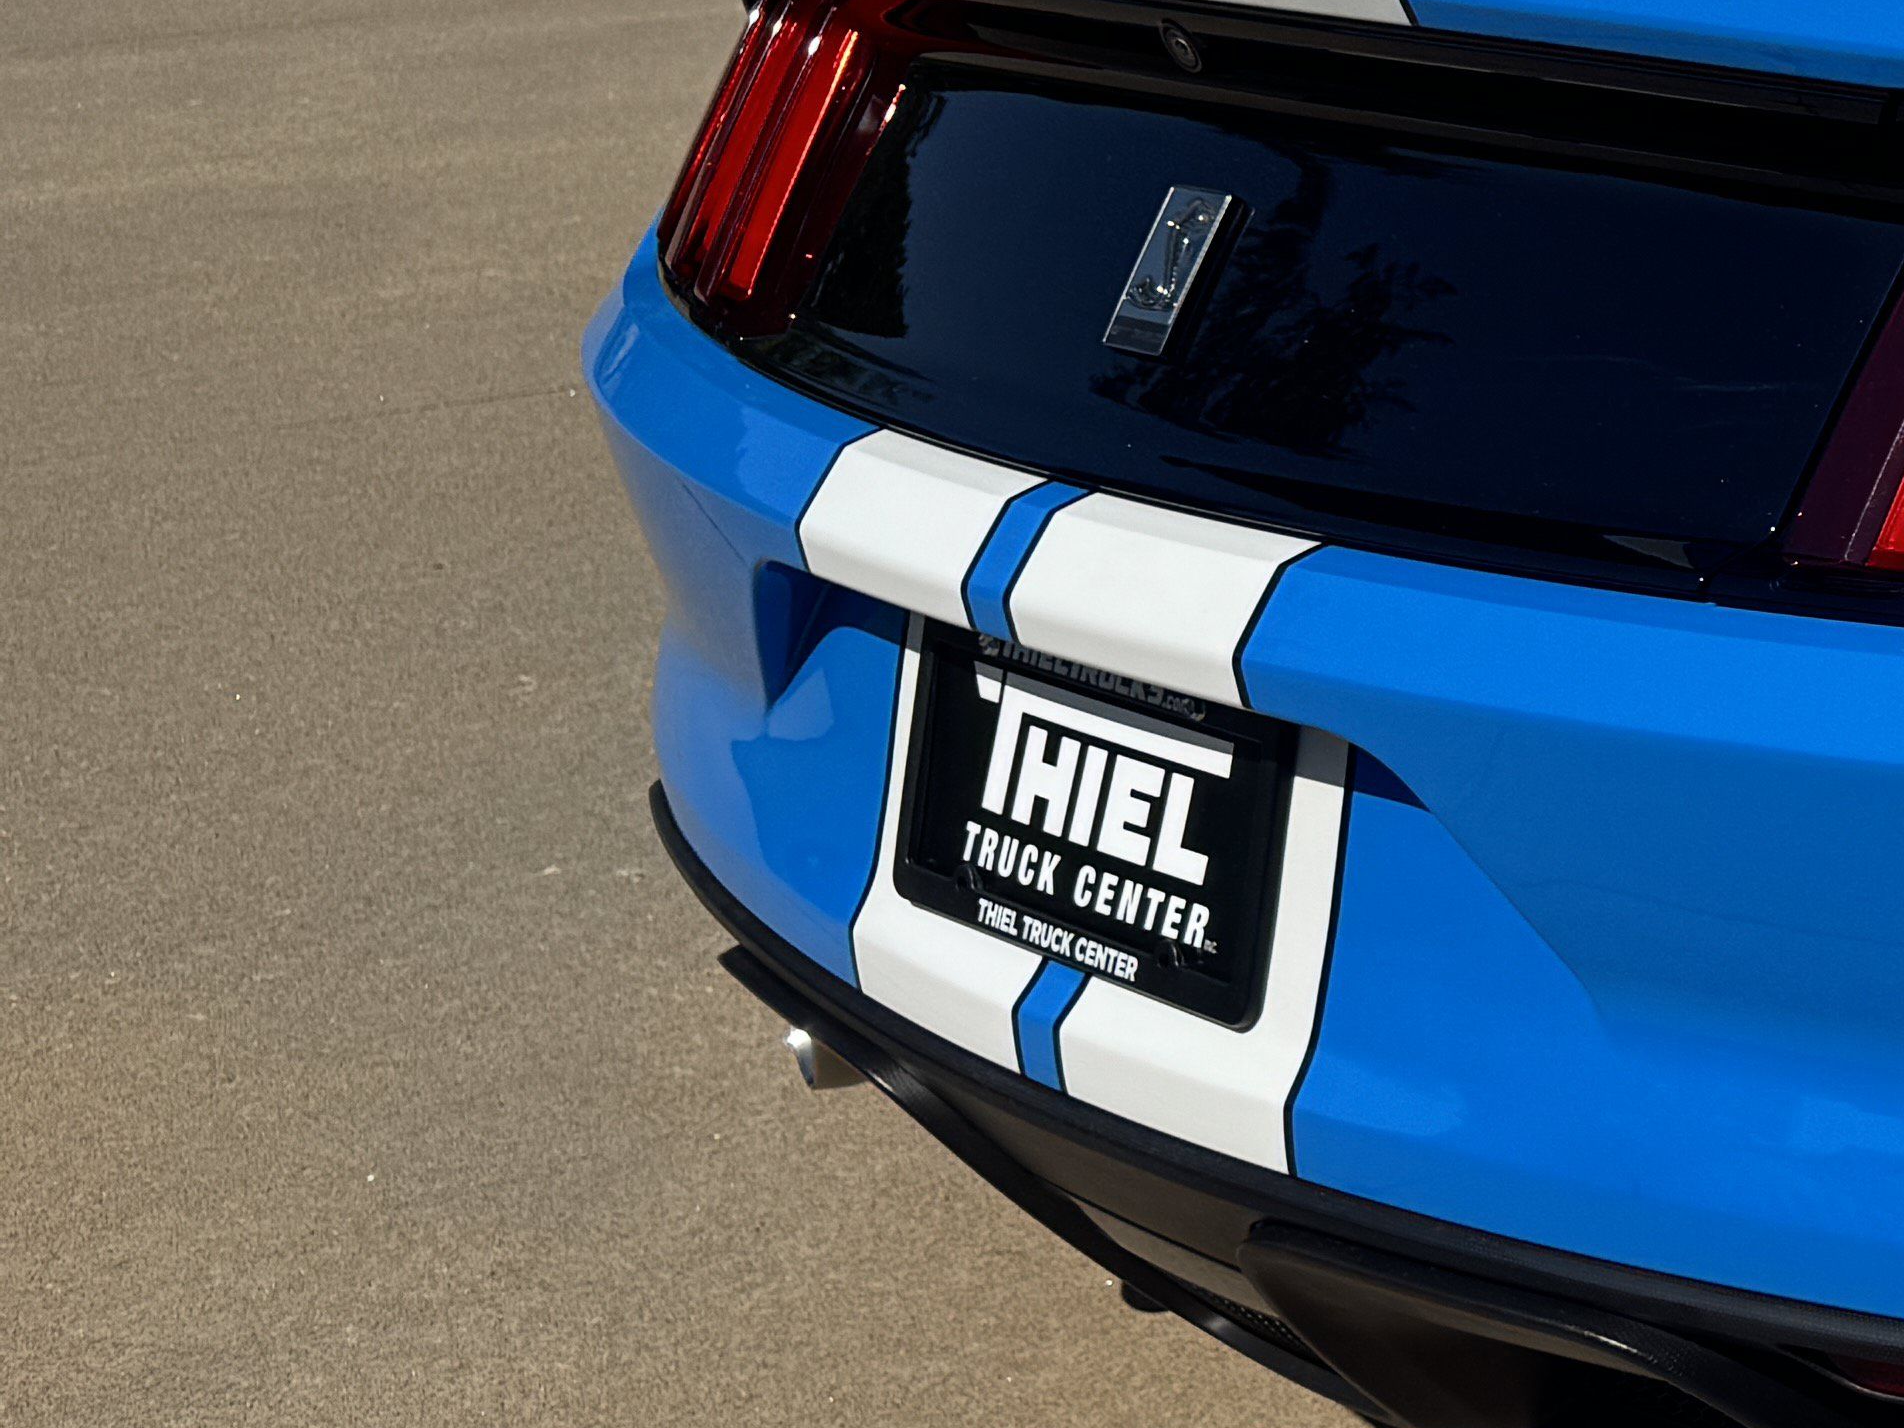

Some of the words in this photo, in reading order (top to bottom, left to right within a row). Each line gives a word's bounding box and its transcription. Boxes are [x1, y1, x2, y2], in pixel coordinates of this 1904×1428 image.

[974, 660, 1234, 887] THIEL
[961, 820, 1062, 896] TRUCK
[1073, 864, 1211, 950] CENTER
[977, 897, 1018, 937] THIEL
[1022, 915, 1075, 958] TRUCK
[1074, 936, 1139, 982] CENTER
